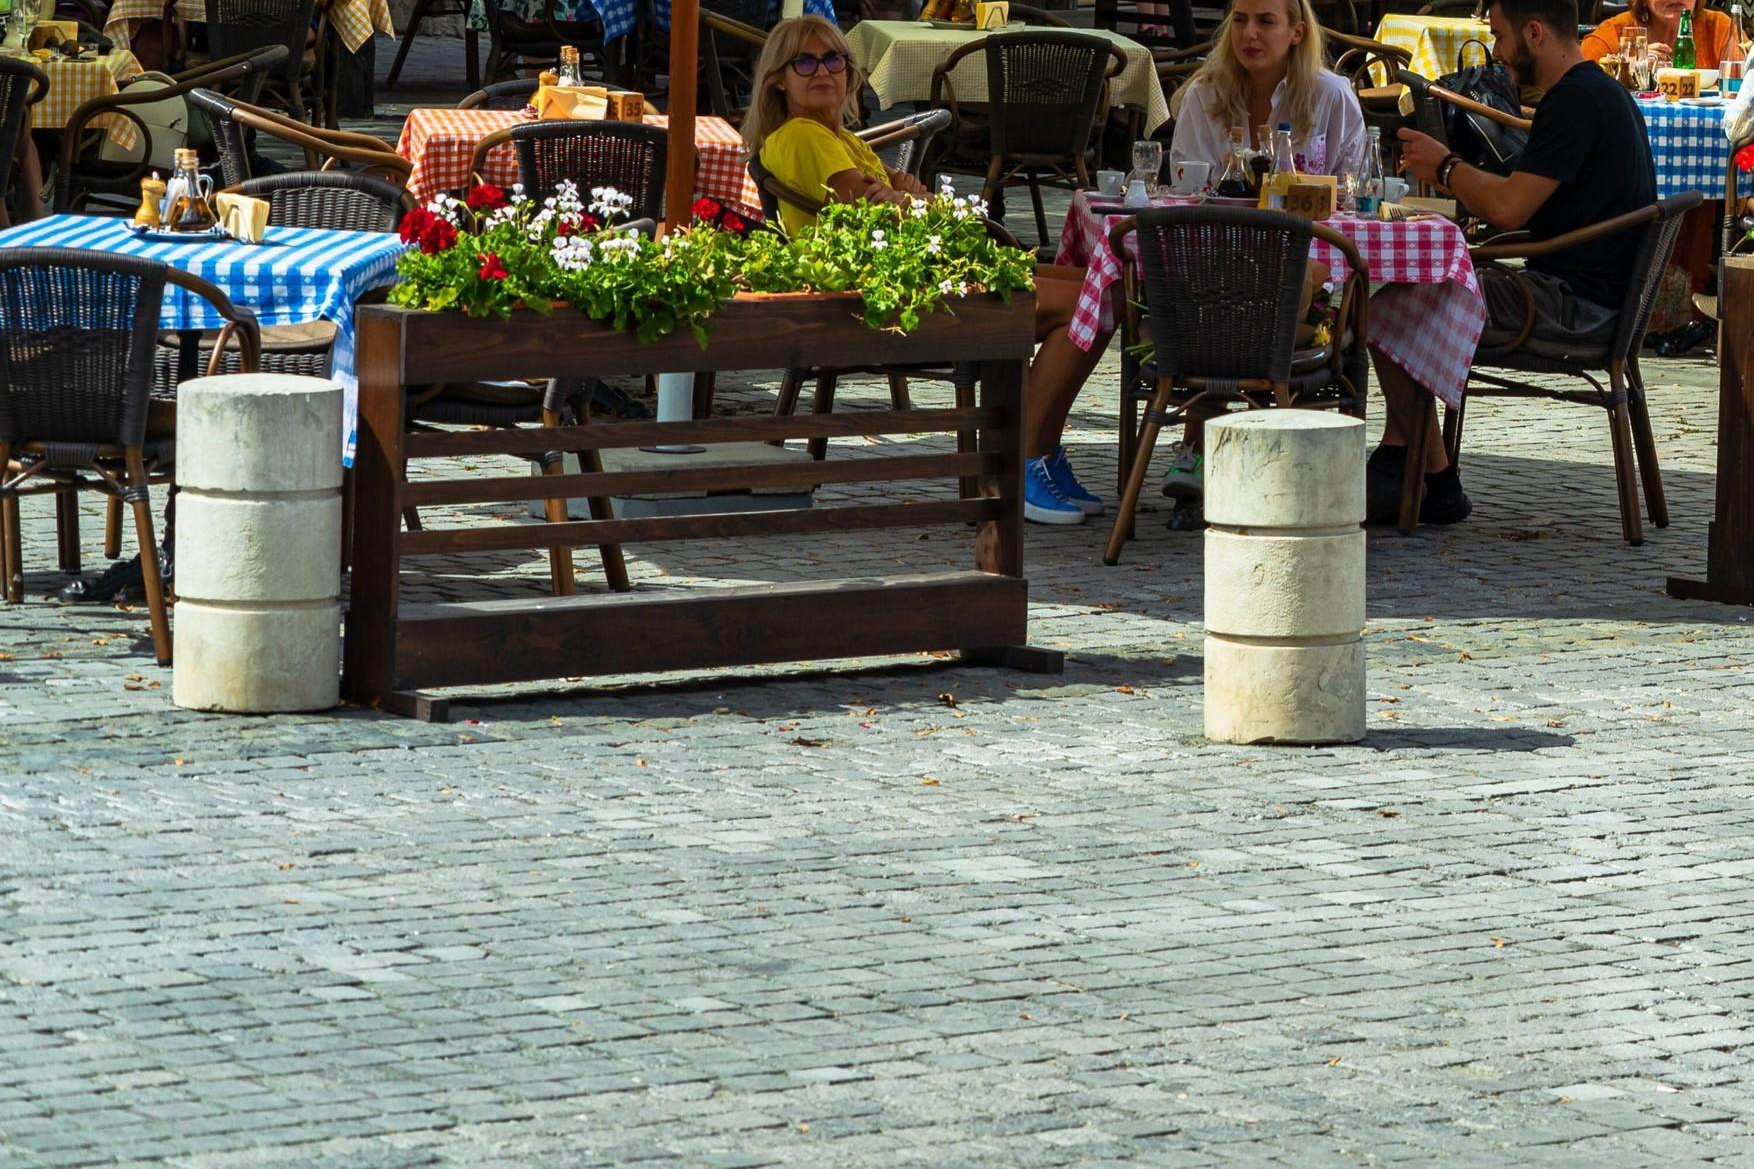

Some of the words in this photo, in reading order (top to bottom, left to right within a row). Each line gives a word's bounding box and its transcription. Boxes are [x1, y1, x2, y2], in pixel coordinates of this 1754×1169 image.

[1661, 81, 1678, 96] 22
[1682, 83, 1694, 96] 22
[626, 102, 641, 117] 35
